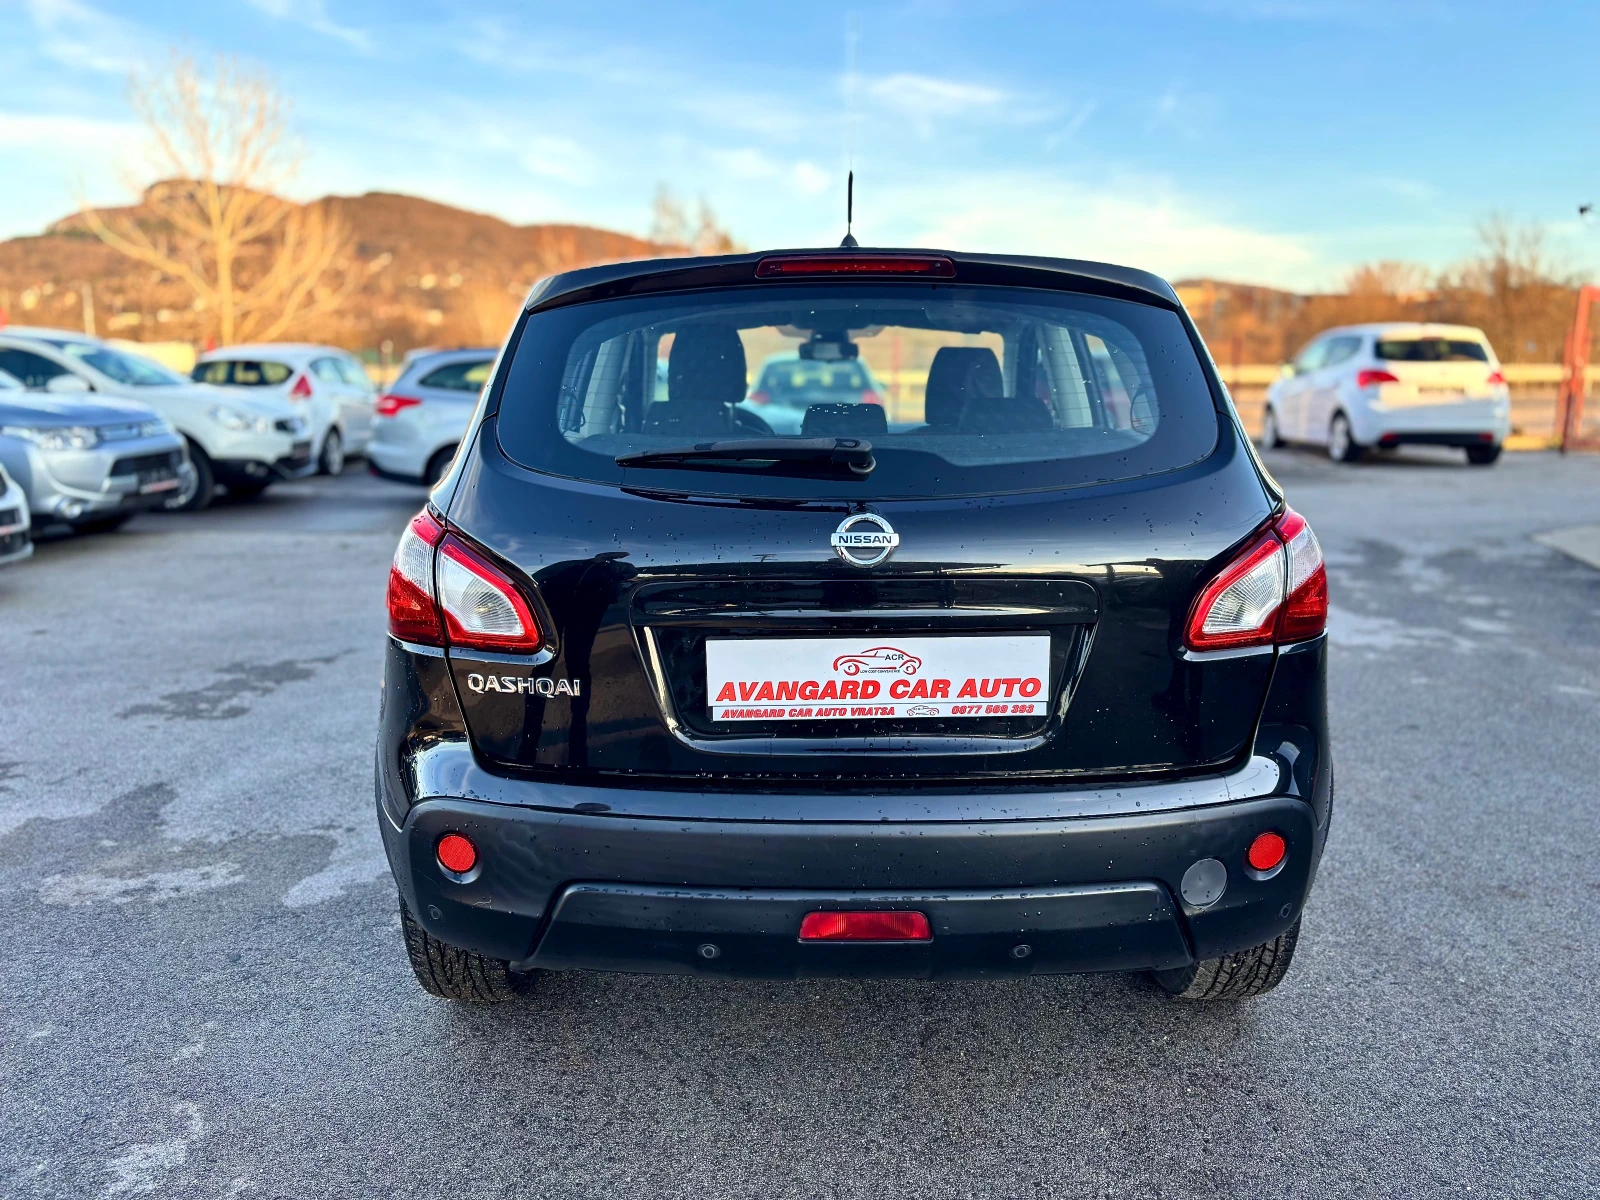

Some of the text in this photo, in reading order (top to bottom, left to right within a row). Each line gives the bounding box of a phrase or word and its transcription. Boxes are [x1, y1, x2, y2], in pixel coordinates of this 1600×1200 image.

[838, 535, 892, 544] NISSAN
[884, 653, 904, 661] ACR
[467, 673, 581, 698] QASHQAI
[716, 678, 1042, 702] AVANGARD CAR AUTO
[721, 706, 895, 719] AVANGARD CAR AUTO VRATSA
[951, 705, 983, 715] 0877
[1010, 704, 1035, 714] 393
